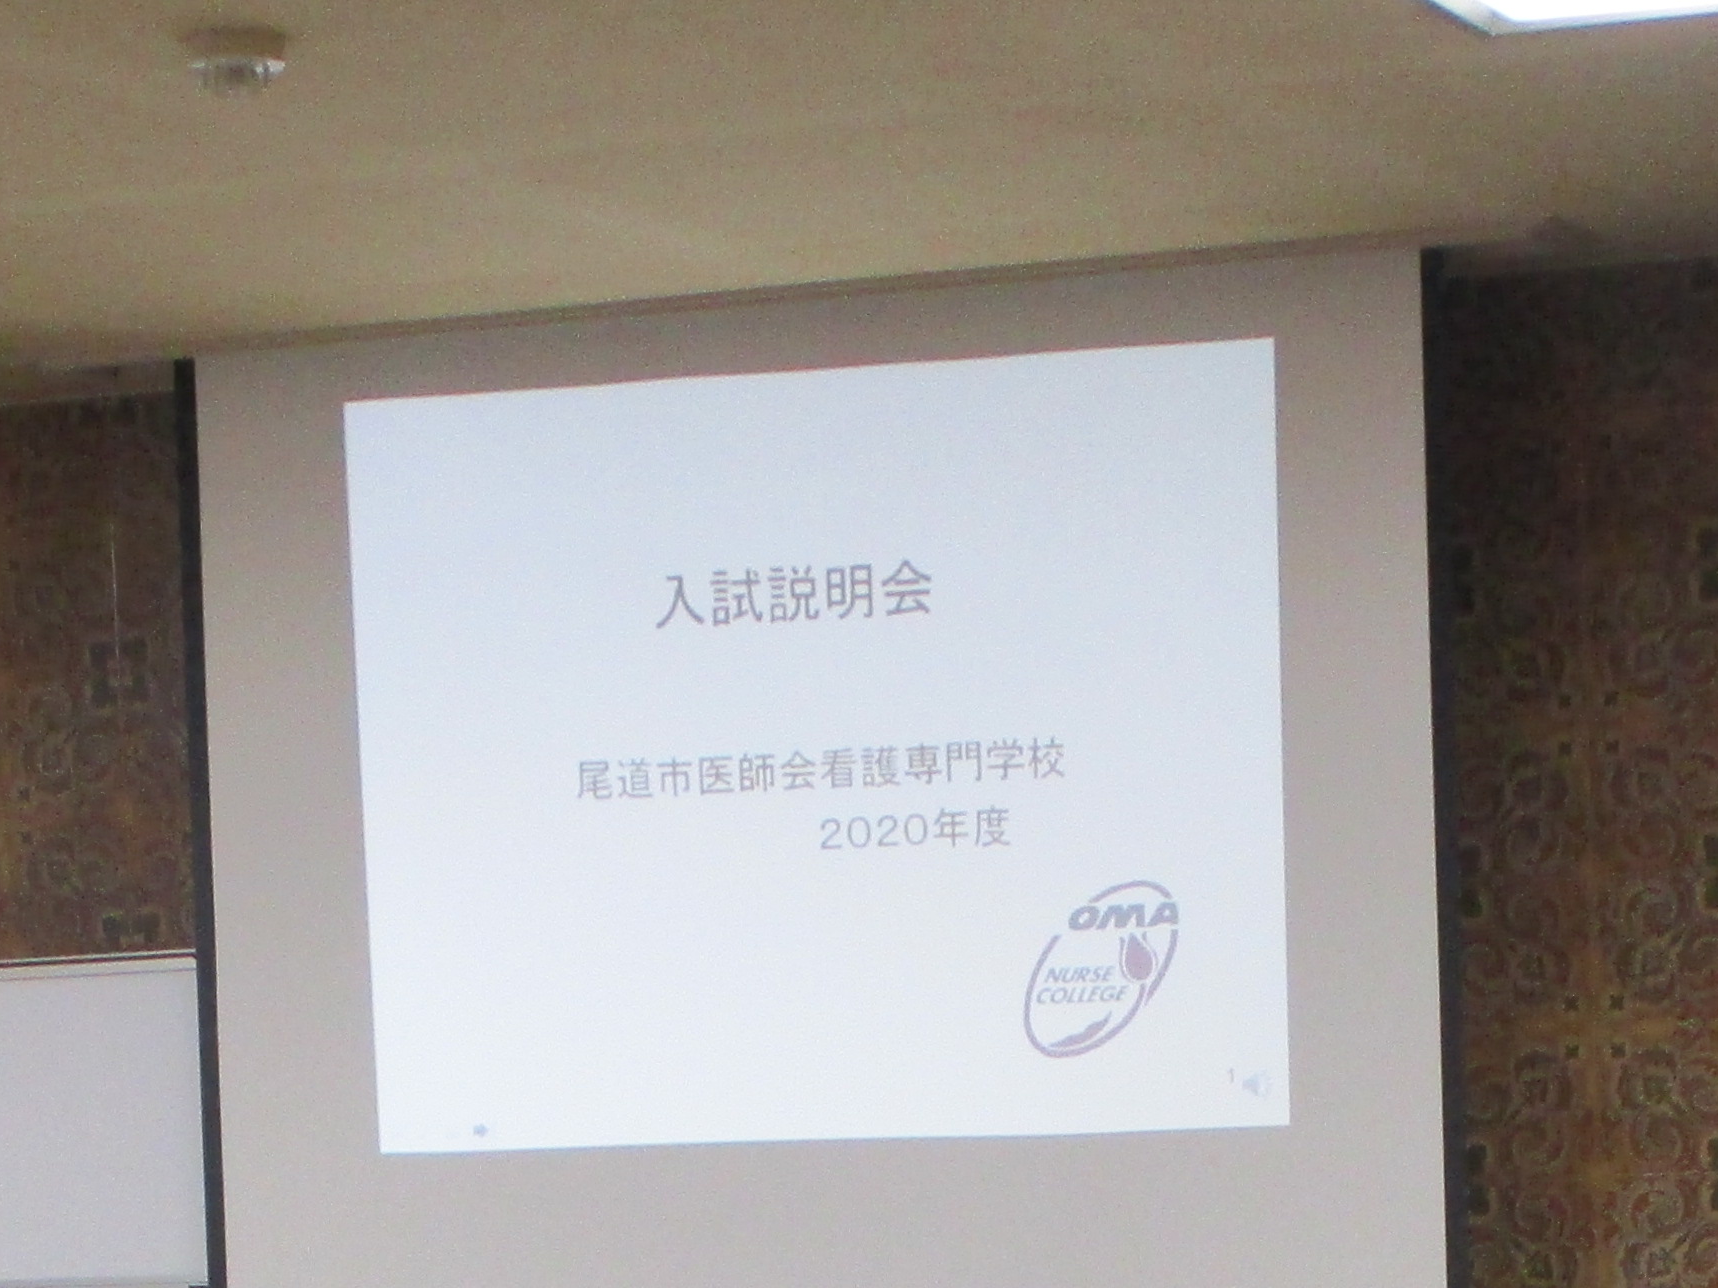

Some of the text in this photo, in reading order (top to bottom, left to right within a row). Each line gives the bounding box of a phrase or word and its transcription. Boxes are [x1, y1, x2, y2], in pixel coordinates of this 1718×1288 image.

[655, 559, 933, 630] 入試説明会
[576, 736, 1066, 800] 尾道市医師会看護専門学校
[819, 804, 1012, 851] 2020年度
[1068, 902, 1179, 931] OMA
[1044, 965, 1116, 984] NURSE
[1036, 984, 1130, 1005] COLLEGE
